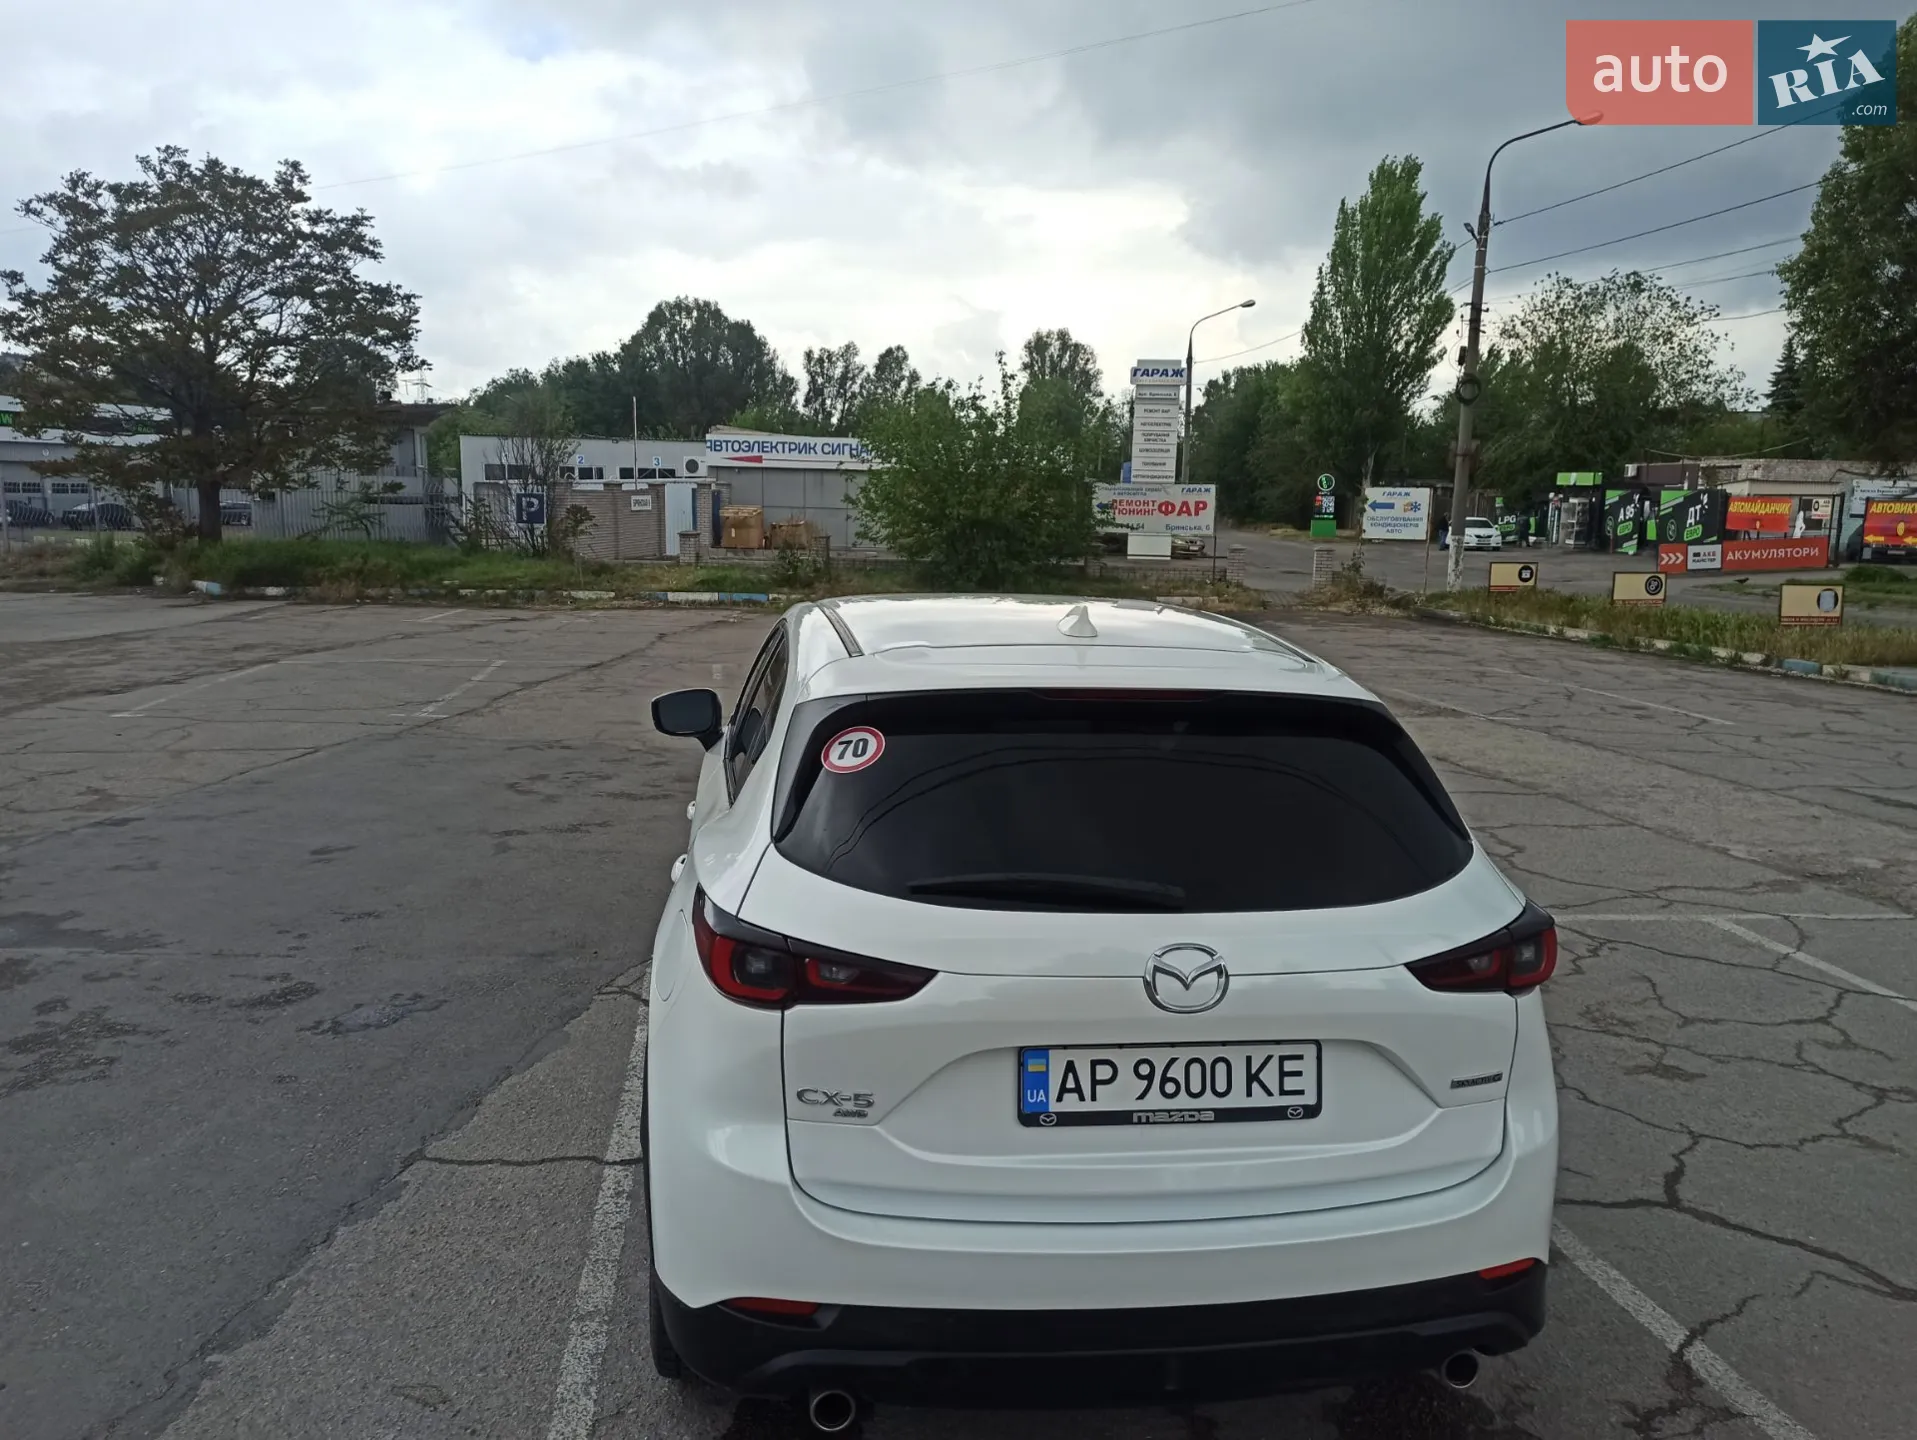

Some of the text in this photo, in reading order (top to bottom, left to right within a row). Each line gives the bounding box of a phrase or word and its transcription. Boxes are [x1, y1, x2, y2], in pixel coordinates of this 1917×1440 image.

[1133, 368, 1184, 378] ГАРАЖ
[578, 456, 584, 464] 2
[654, 458, 660, 466] 3
[522, 497, 540, 521] P
[1158, 500, 1208, 516] ФАР
[1728, 500, 1792, 515] АВТОМАЙДАНЧИК
[1869, 502, 1917, 514] АВТОВИК
[1498, 514, 1516, 524] LPG
[1726, 547, 1820, 560] АКУМУЛЯТОРИ
[838, 738, 868, 760] 70
[1055, 1054, 1305, 1103] AP 9600 KE
[797, 1087, 875, 1109] CX-5
[1027, 1089, 1046, 1102] UA
